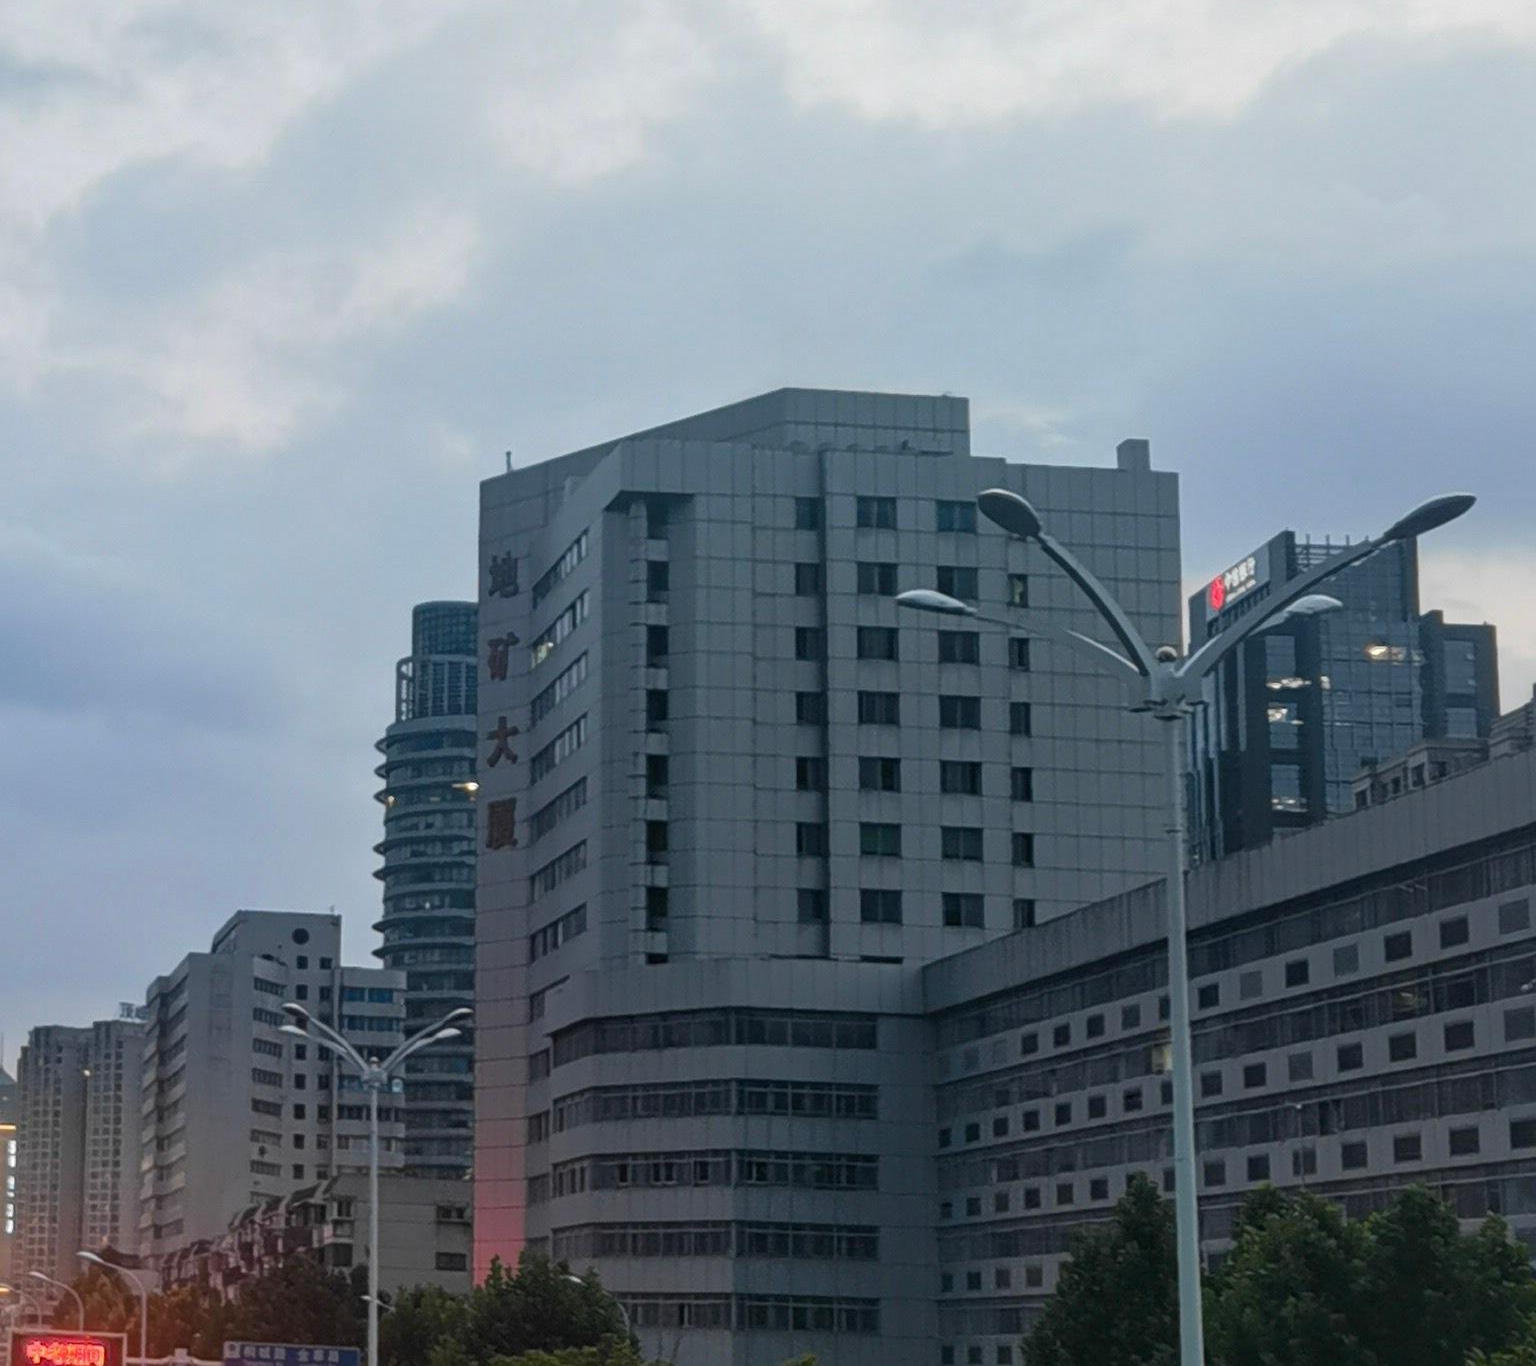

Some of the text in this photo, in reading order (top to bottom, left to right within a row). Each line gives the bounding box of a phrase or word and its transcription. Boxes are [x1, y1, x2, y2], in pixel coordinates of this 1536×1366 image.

[486, 551, 519, 850] 地矿大厦
[26, 1341, 104, 1366] 中考期间
